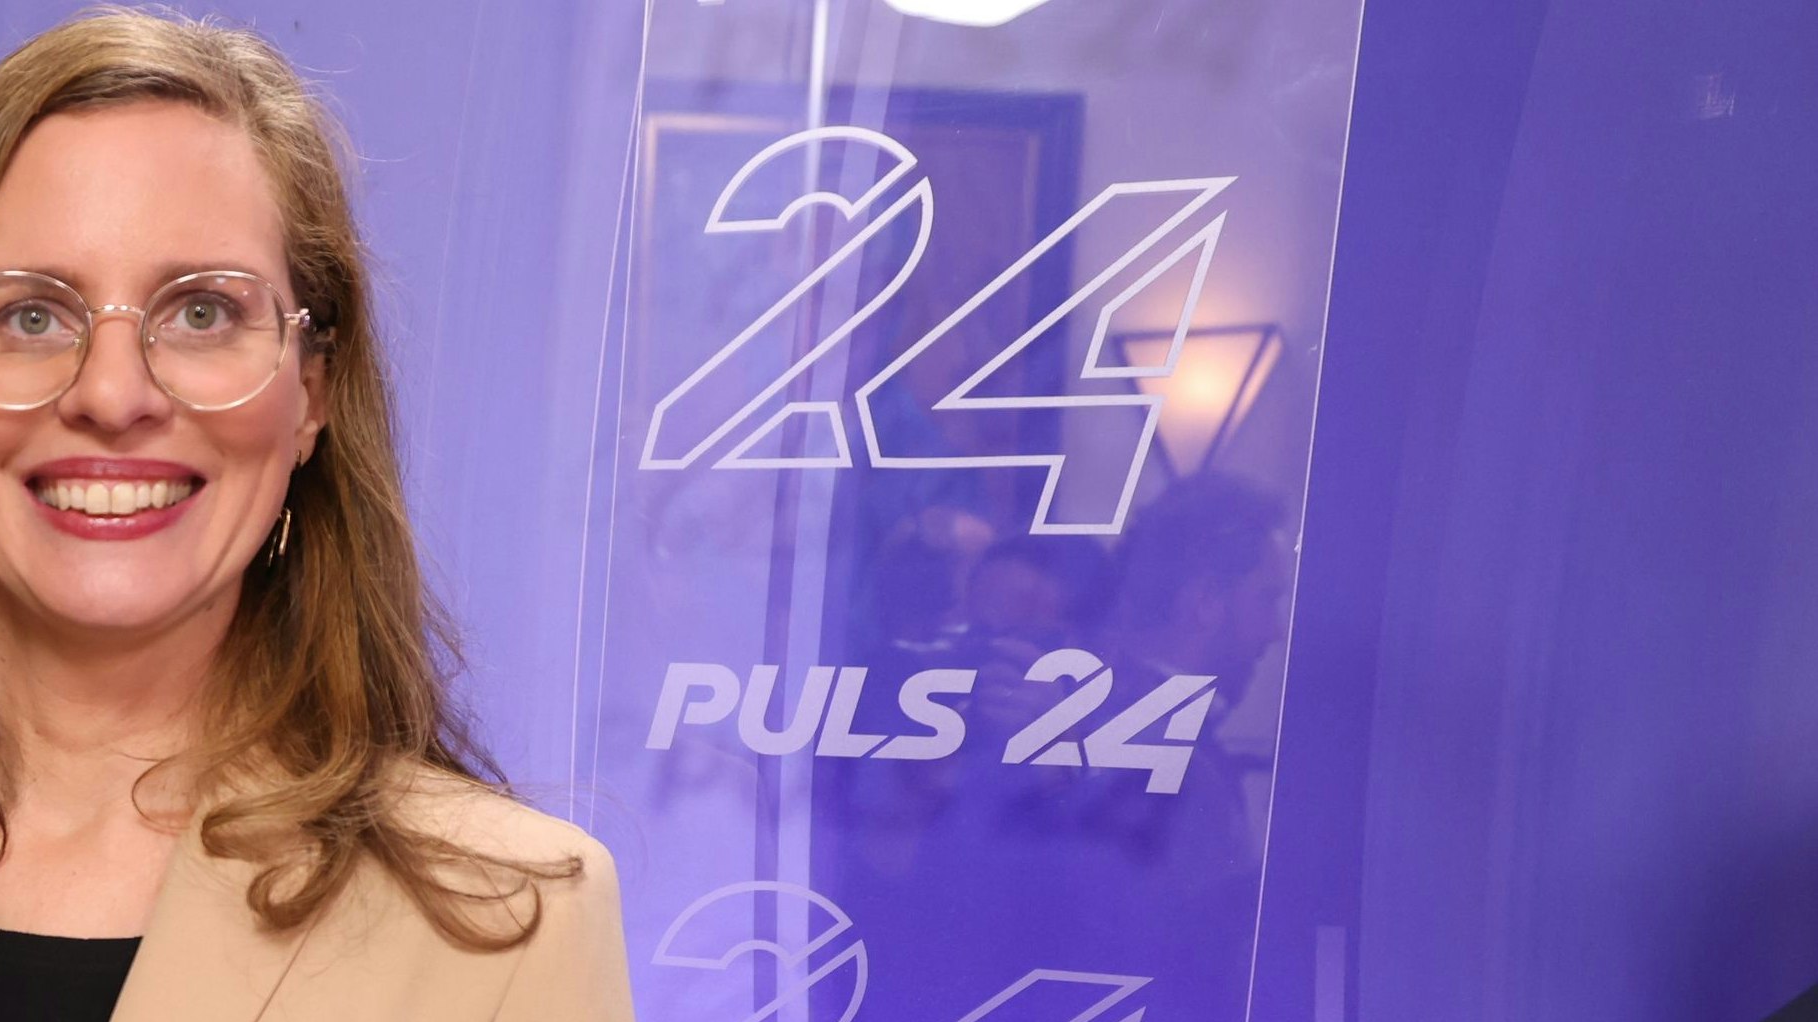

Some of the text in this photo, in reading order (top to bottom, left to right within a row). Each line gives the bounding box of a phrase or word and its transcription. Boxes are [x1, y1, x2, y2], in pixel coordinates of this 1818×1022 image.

[639, 125, 1239, 536] 24
[645, 647, 1219, 795] PULS 24
